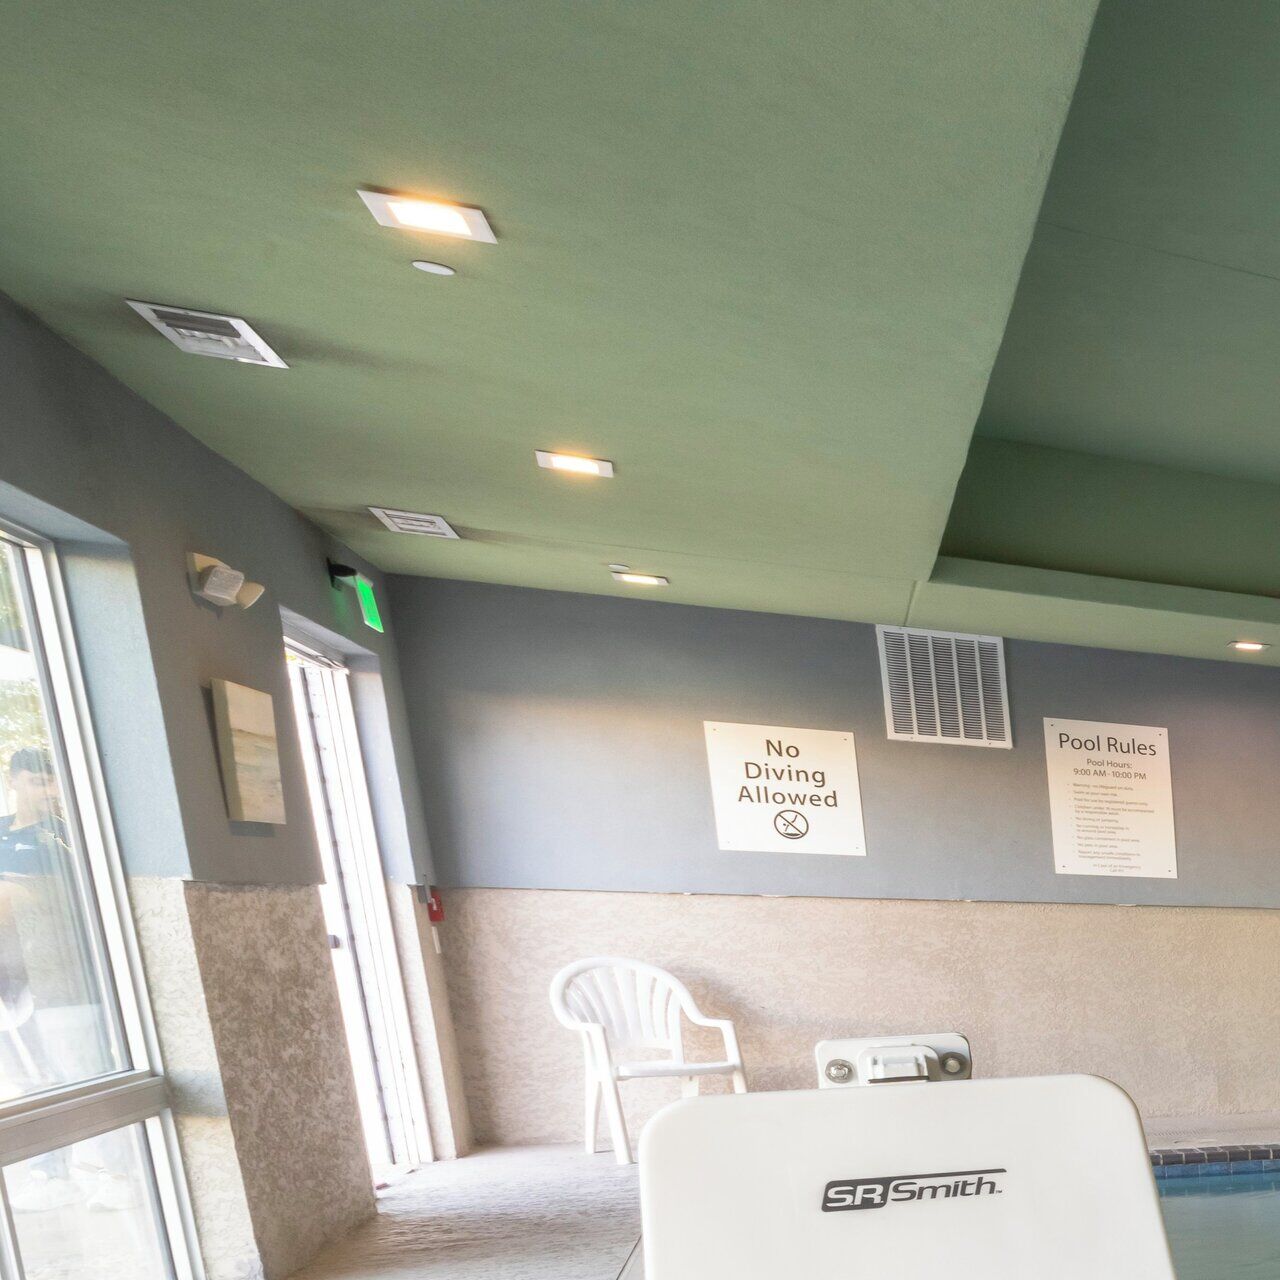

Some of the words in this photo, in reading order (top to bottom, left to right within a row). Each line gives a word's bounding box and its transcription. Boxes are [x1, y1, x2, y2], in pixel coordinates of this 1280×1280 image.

[765, 739, 800, 758] No
[1058, 732, 1101, 752] Pool
[1106, 737, 1157, 756] Rules
[744, 761, 826, 788] Diving
[1073, 768, 1091, 776] 9:00
[1092, 769, 1107, 777] AM
[1133, 772, 1147, 780] PM
[1086, 758, 1105, 767] Pool
[1106, 760, 1133, 769] Hours:
[738, 785, 838, 807] Allowed
[890, 1176, 997, 1202] Smith
